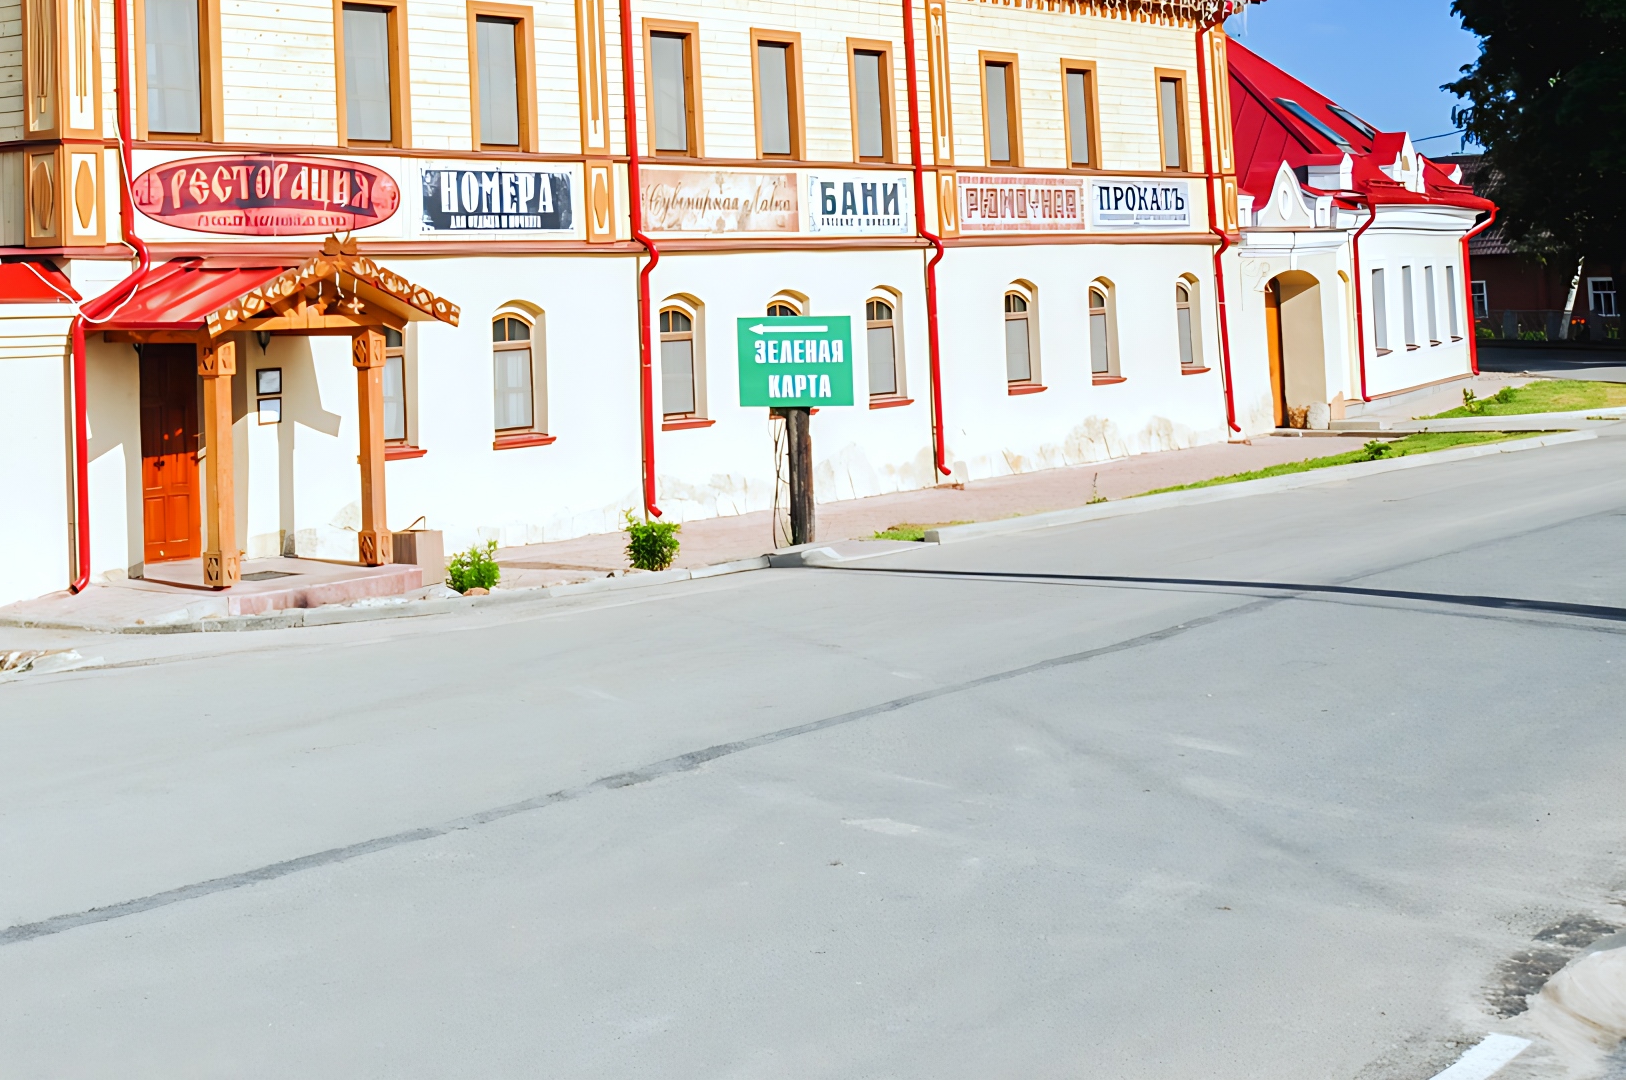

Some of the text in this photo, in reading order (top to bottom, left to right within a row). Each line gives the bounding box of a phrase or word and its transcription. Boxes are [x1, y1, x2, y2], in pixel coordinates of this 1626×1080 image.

[171, 164, 369, 211] РЕСТОРАЦИЯ
[440, 171, 555, 214] НОМЕРА
[820, 181, 900, 216] БАНИ
[965, 187, 1077, 219] РЮМОЧНАЯ
[1099, 186, 1185, 211] ПРОКАТЪ
[754, 339, 844, 364] ЗЕЛЕНАЯ
[768, 374, 832, 398] КАРТА
